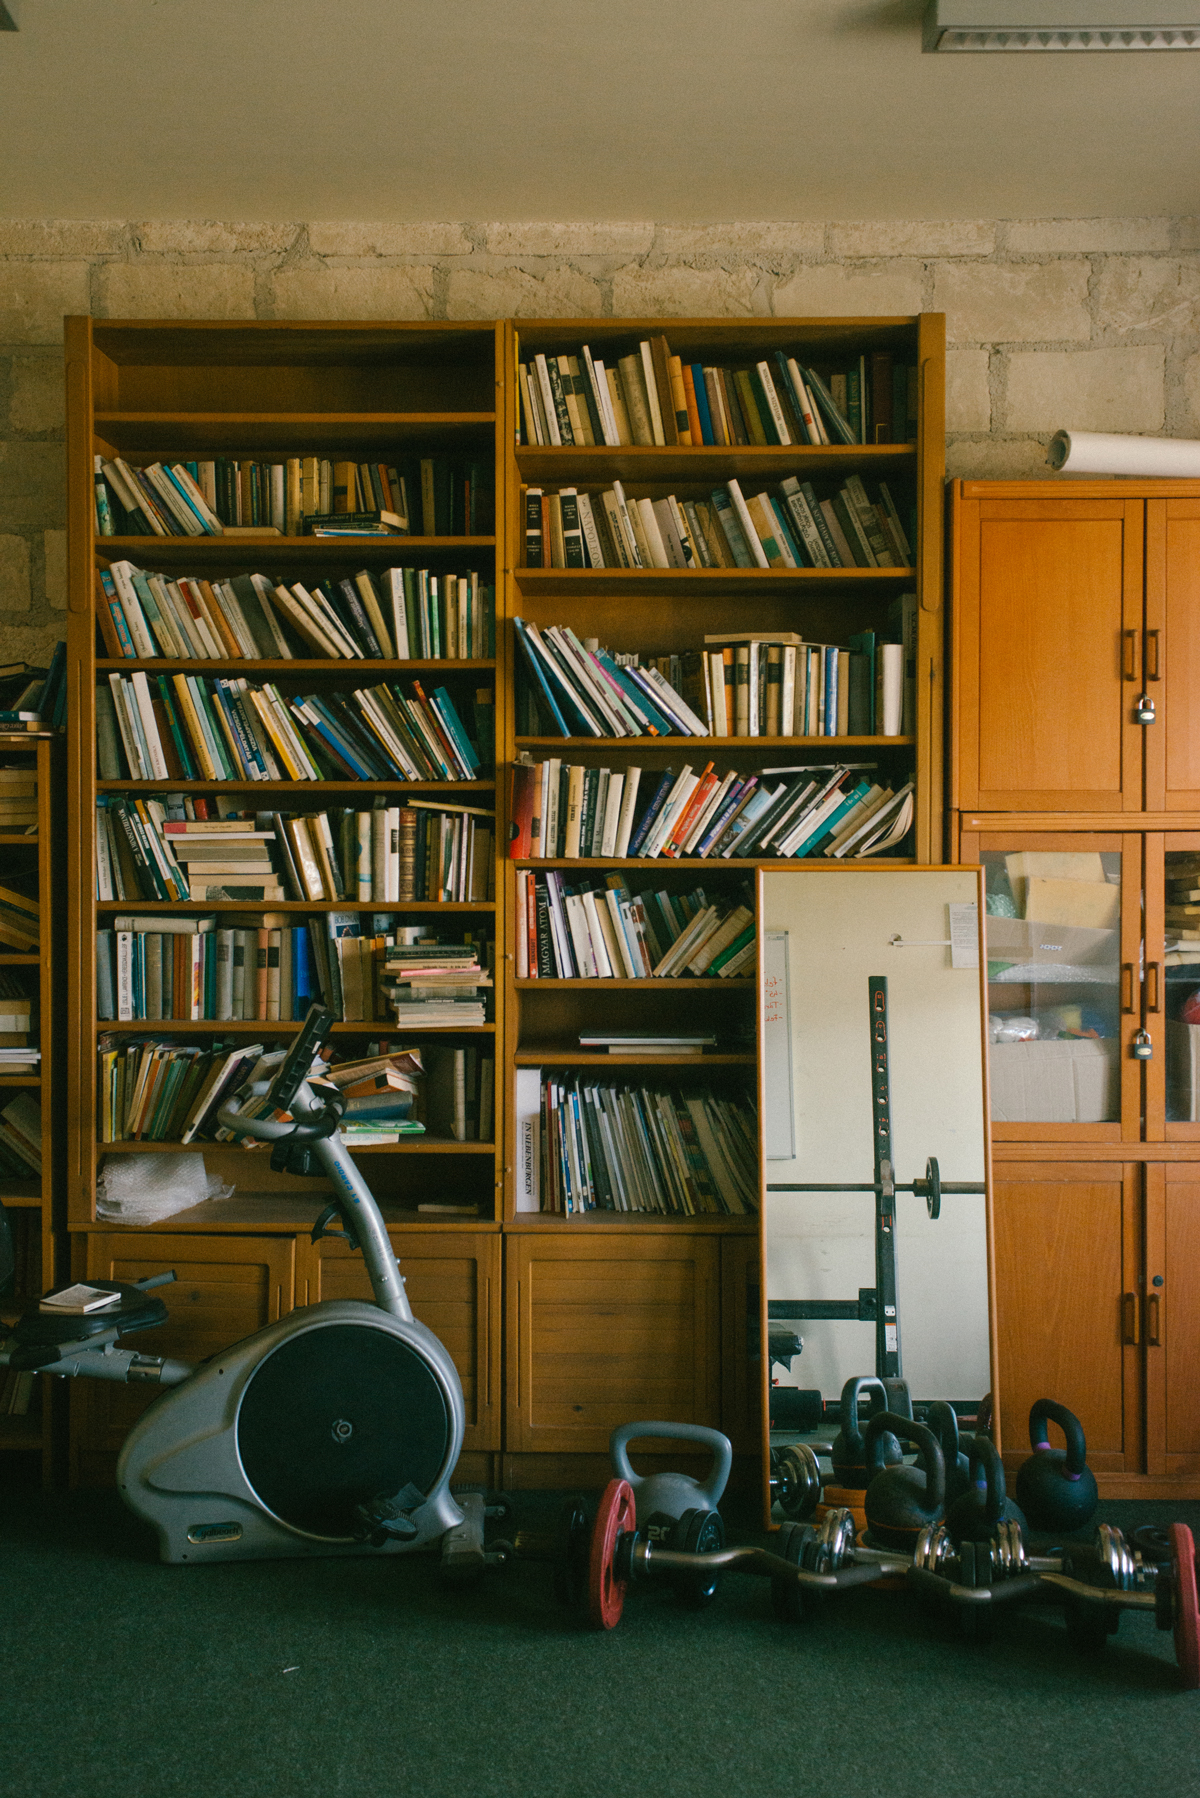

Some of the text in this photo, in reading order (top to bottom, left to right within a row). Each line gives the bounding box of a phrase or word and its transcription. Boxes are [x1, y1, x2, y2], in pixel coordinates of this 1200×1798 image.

[581, 511, 603, 569] NAPOLEON
[231, 708, 252, 760] VIZSGAPÉLDATÁR
[236, 700, 257, 751] VIZSGAPÉLDATÁR
[335, 916, 344, 924] BOB
[538, 901, 550, 973] MAGYAR ATOM
[334, 1160, 354, 1191] CARDIO
[524, 1122, 532, 1195] IN SIEBENBÜRGEN
